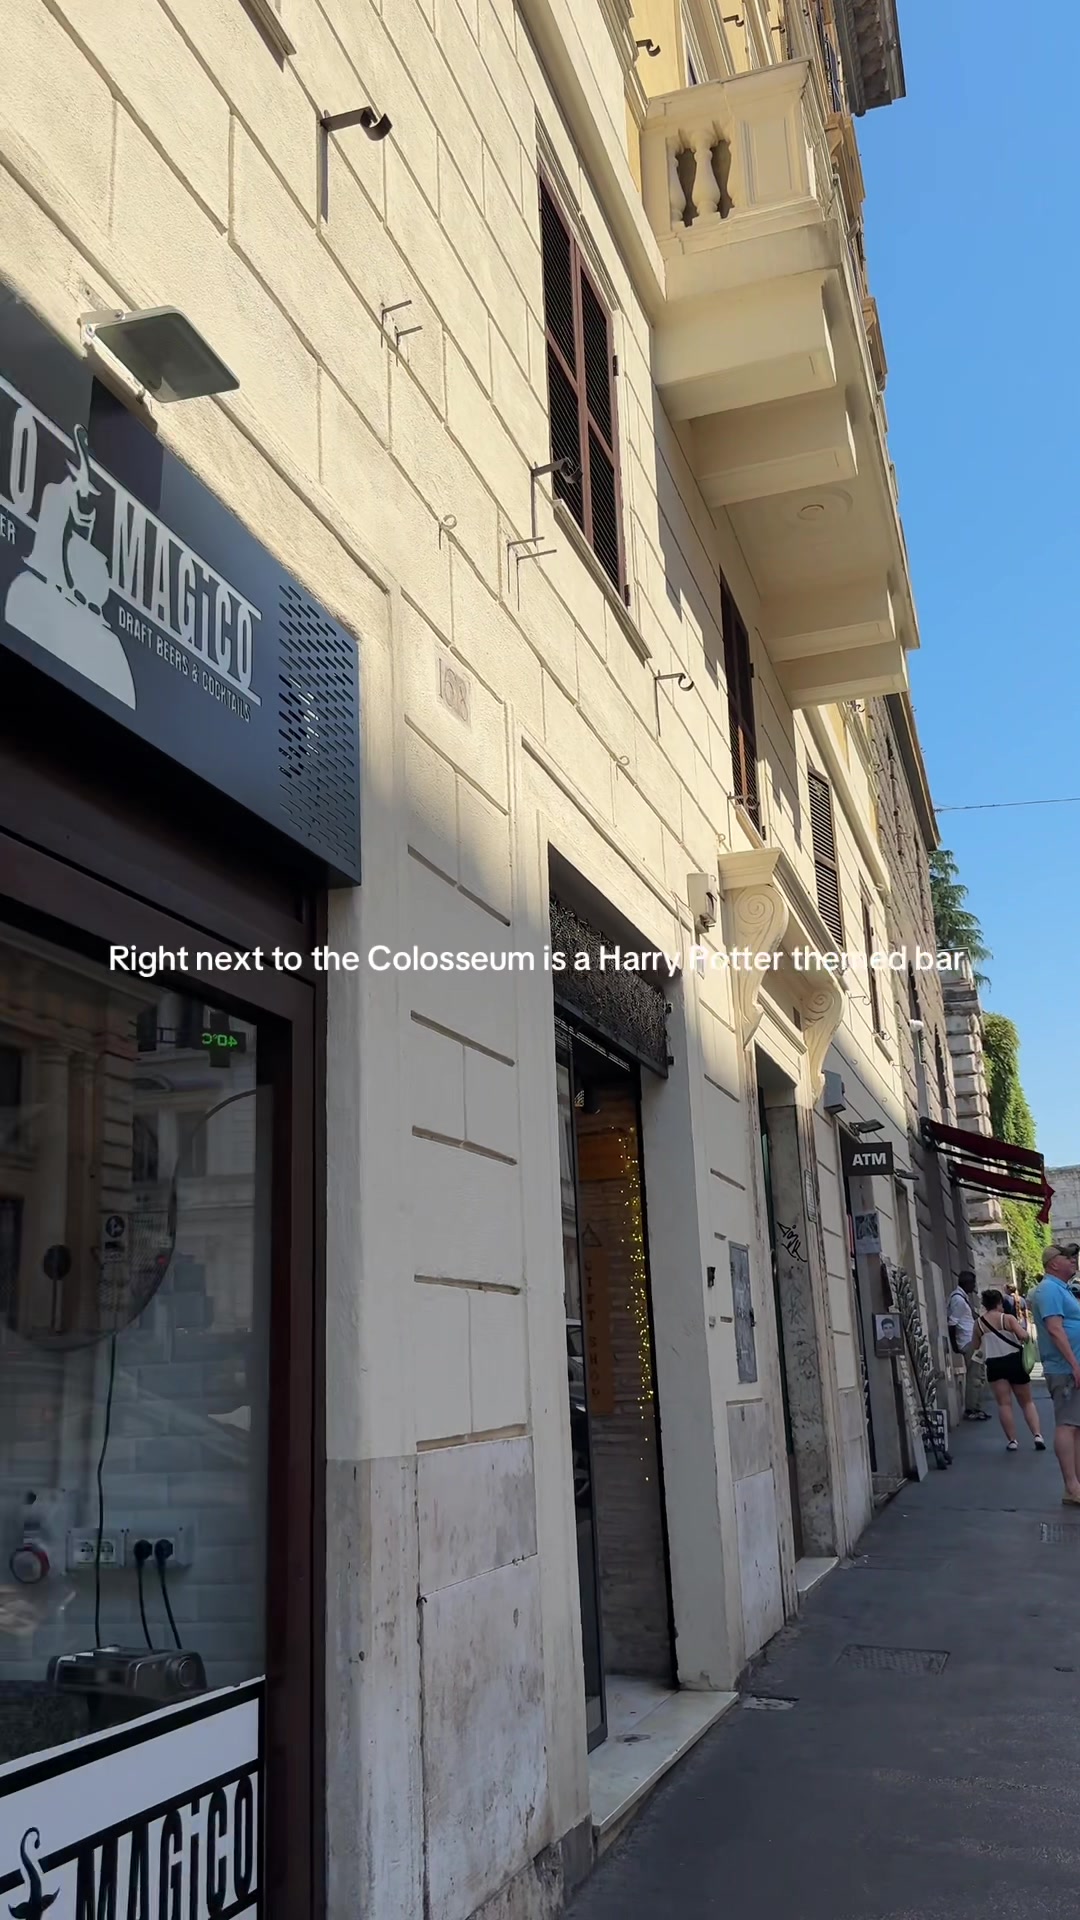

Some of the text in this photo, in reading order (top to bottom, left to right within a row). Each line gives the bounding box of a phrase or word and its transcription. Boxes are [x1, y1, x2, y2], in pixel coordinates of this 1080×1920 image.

[118, 605, 252, 723] DRAFT BEERS & COCKTAILS
[852, 1152, 887, 1167] ATM
